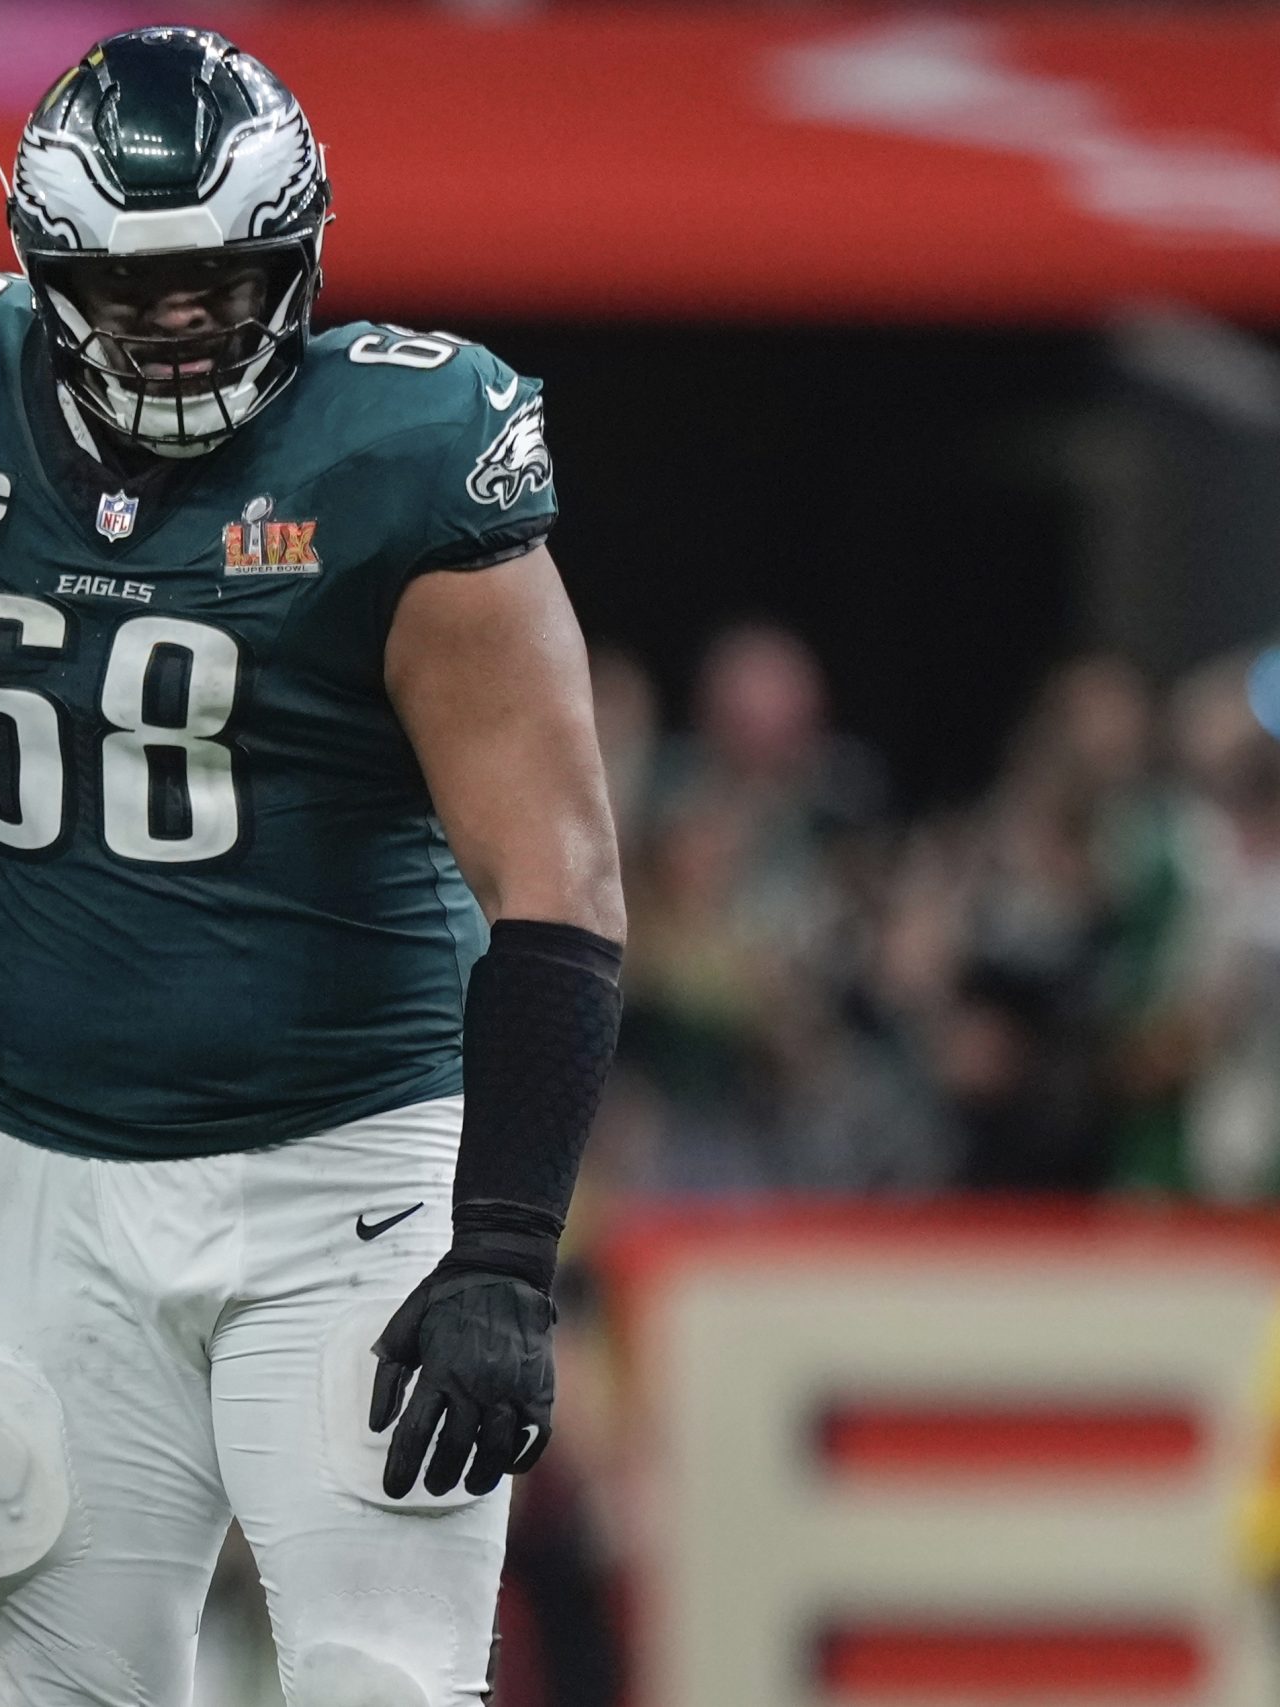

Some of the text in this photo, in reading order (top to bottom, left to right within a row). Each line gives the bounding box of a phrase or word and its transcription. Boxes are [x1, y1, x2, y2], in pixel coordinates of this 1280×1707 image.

[102, 511, 128, 532] NFL
[235, 564, 309, 574] SUPER BOWL
[54, 574, 156, 604] EAGLES
